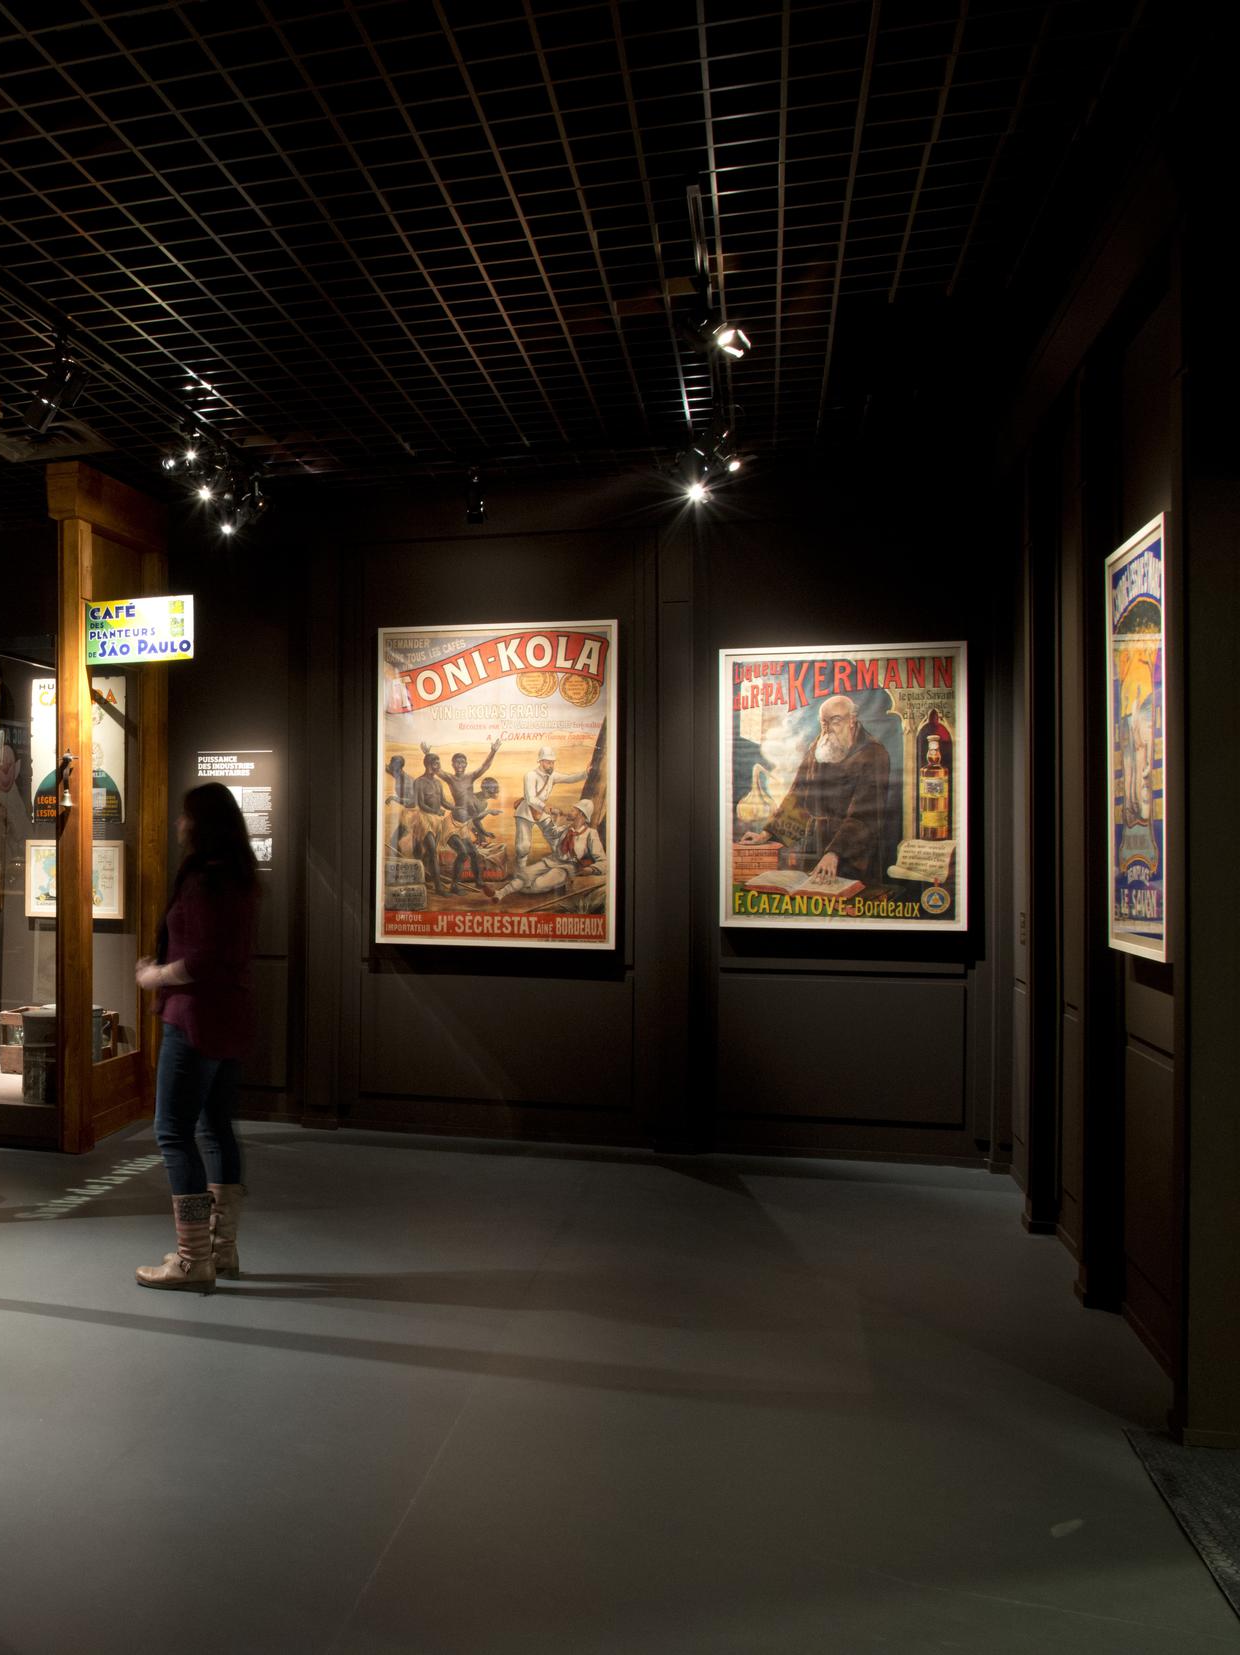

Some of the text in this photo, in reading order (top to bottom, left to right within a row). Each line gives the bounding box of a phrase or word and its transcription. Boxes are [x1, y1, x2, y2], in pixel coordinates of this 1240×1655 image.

[89, 602, 136, 620] CAFÉ
[89, 627, 156, 640] PLANTEURS
[98, 640, 130, 658] SÃO
[138, 639, 192, 654] PAULO
[387, 639, 430, 650] DEMANDER
[395, 634, 602, 709] TONI-KOLA
[734, 661, 785, 685] Liqueur
[787, 656, 954, 712] KERMANN
[431, 706, 454, 721] VIN
[467, 704, 506, 719] KOLAS
[510, 703, 548, 717] FRAIS
[212, 762, 255, 770] INDUSTRIES
[855, 897, 920, 918] Bordeaux
[396, 914, 422, 923] UNIQUE
[455, 913, 537, 934] SÉCRESTAT
[556, 917, 604, 936] BORDEAUX
[386, 924, 431, 932] IMPORTATEUR
